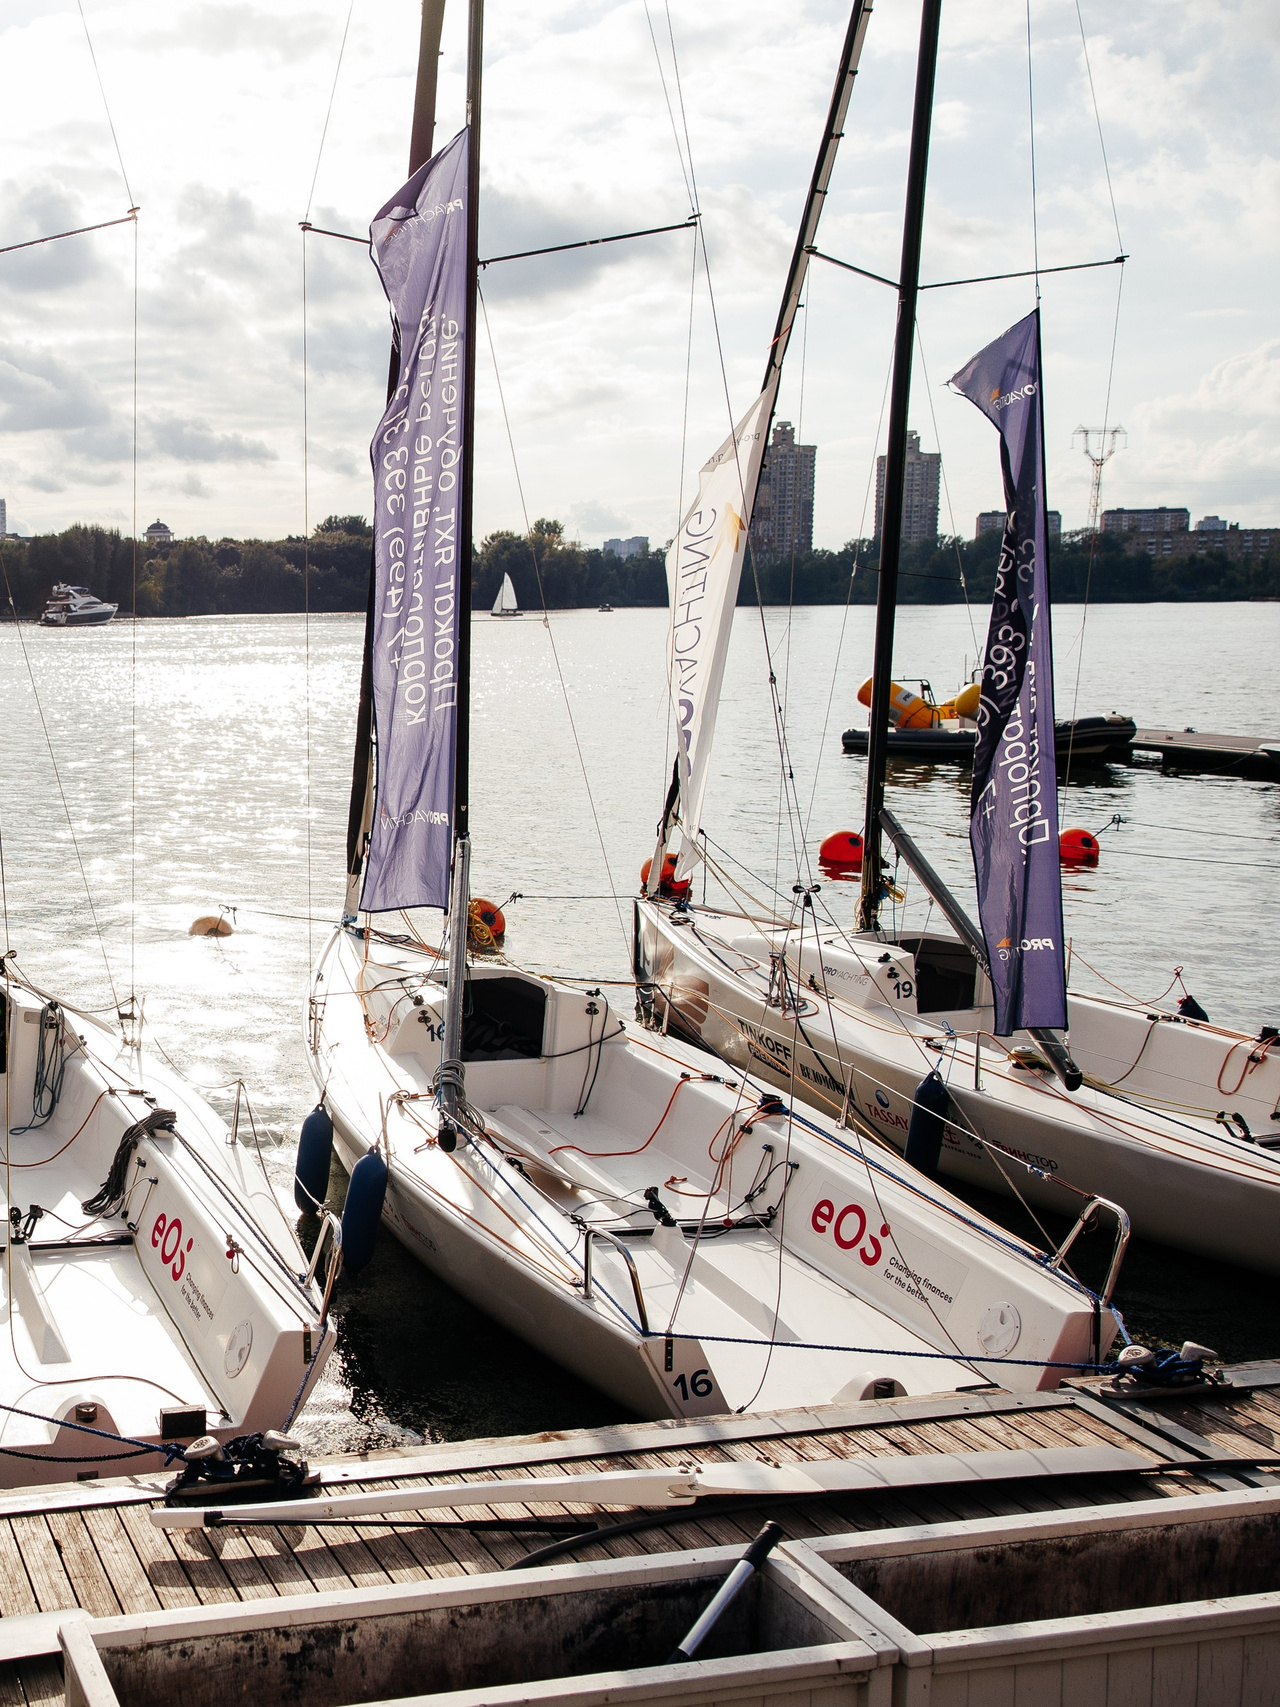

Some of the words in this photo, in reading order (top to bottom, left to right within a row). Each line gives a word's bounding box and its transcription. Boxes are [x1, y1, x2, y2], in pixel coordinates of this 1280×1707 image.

[823, 966, 869, 986] PROYACHTING
[893, 981, 913, 999] 19
[737, 1018, 792, 1060] TINKOFF
[865, 1102, 910, 1131] TASSAY
[883, 1268, 895, 1280] for
[894, 1276, 906, 1288] the
[889, 1256, 922, 1285] Changing
[922, 1278, 953, 1304] finances
[673, 1368, 713, 1401] 16
